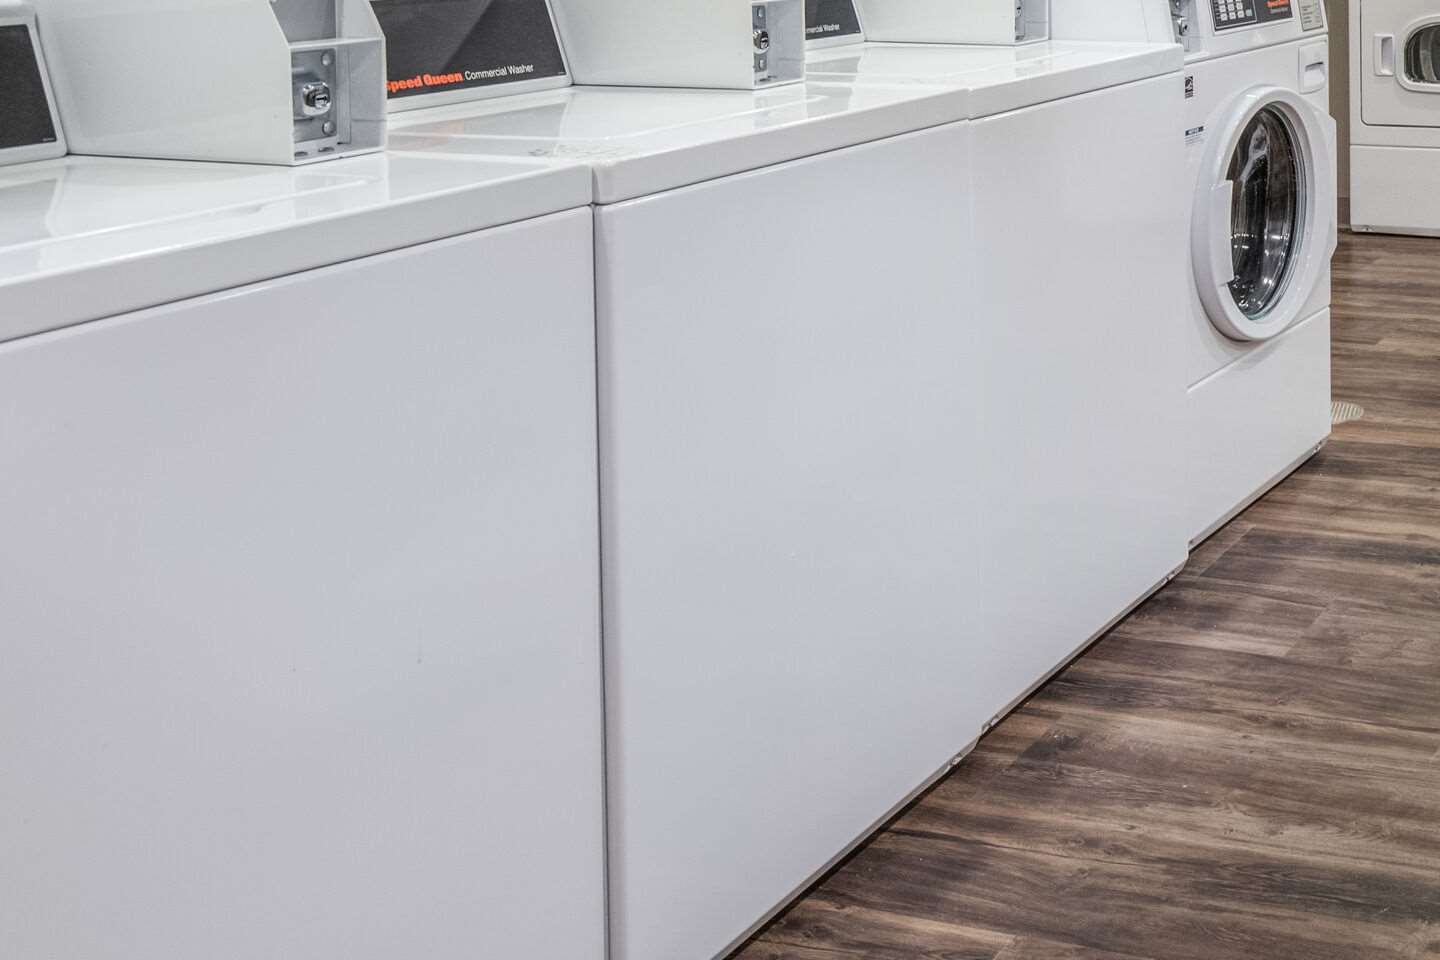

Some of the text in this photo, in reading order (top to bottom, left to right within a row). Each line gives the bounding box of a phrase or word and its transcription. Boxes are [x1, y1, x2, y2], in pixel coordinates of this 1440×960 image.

[423, 72, 464, 86] Queen
[465, 66, 507, 80] Commercial
[508, 64, 534, 75] Washer
